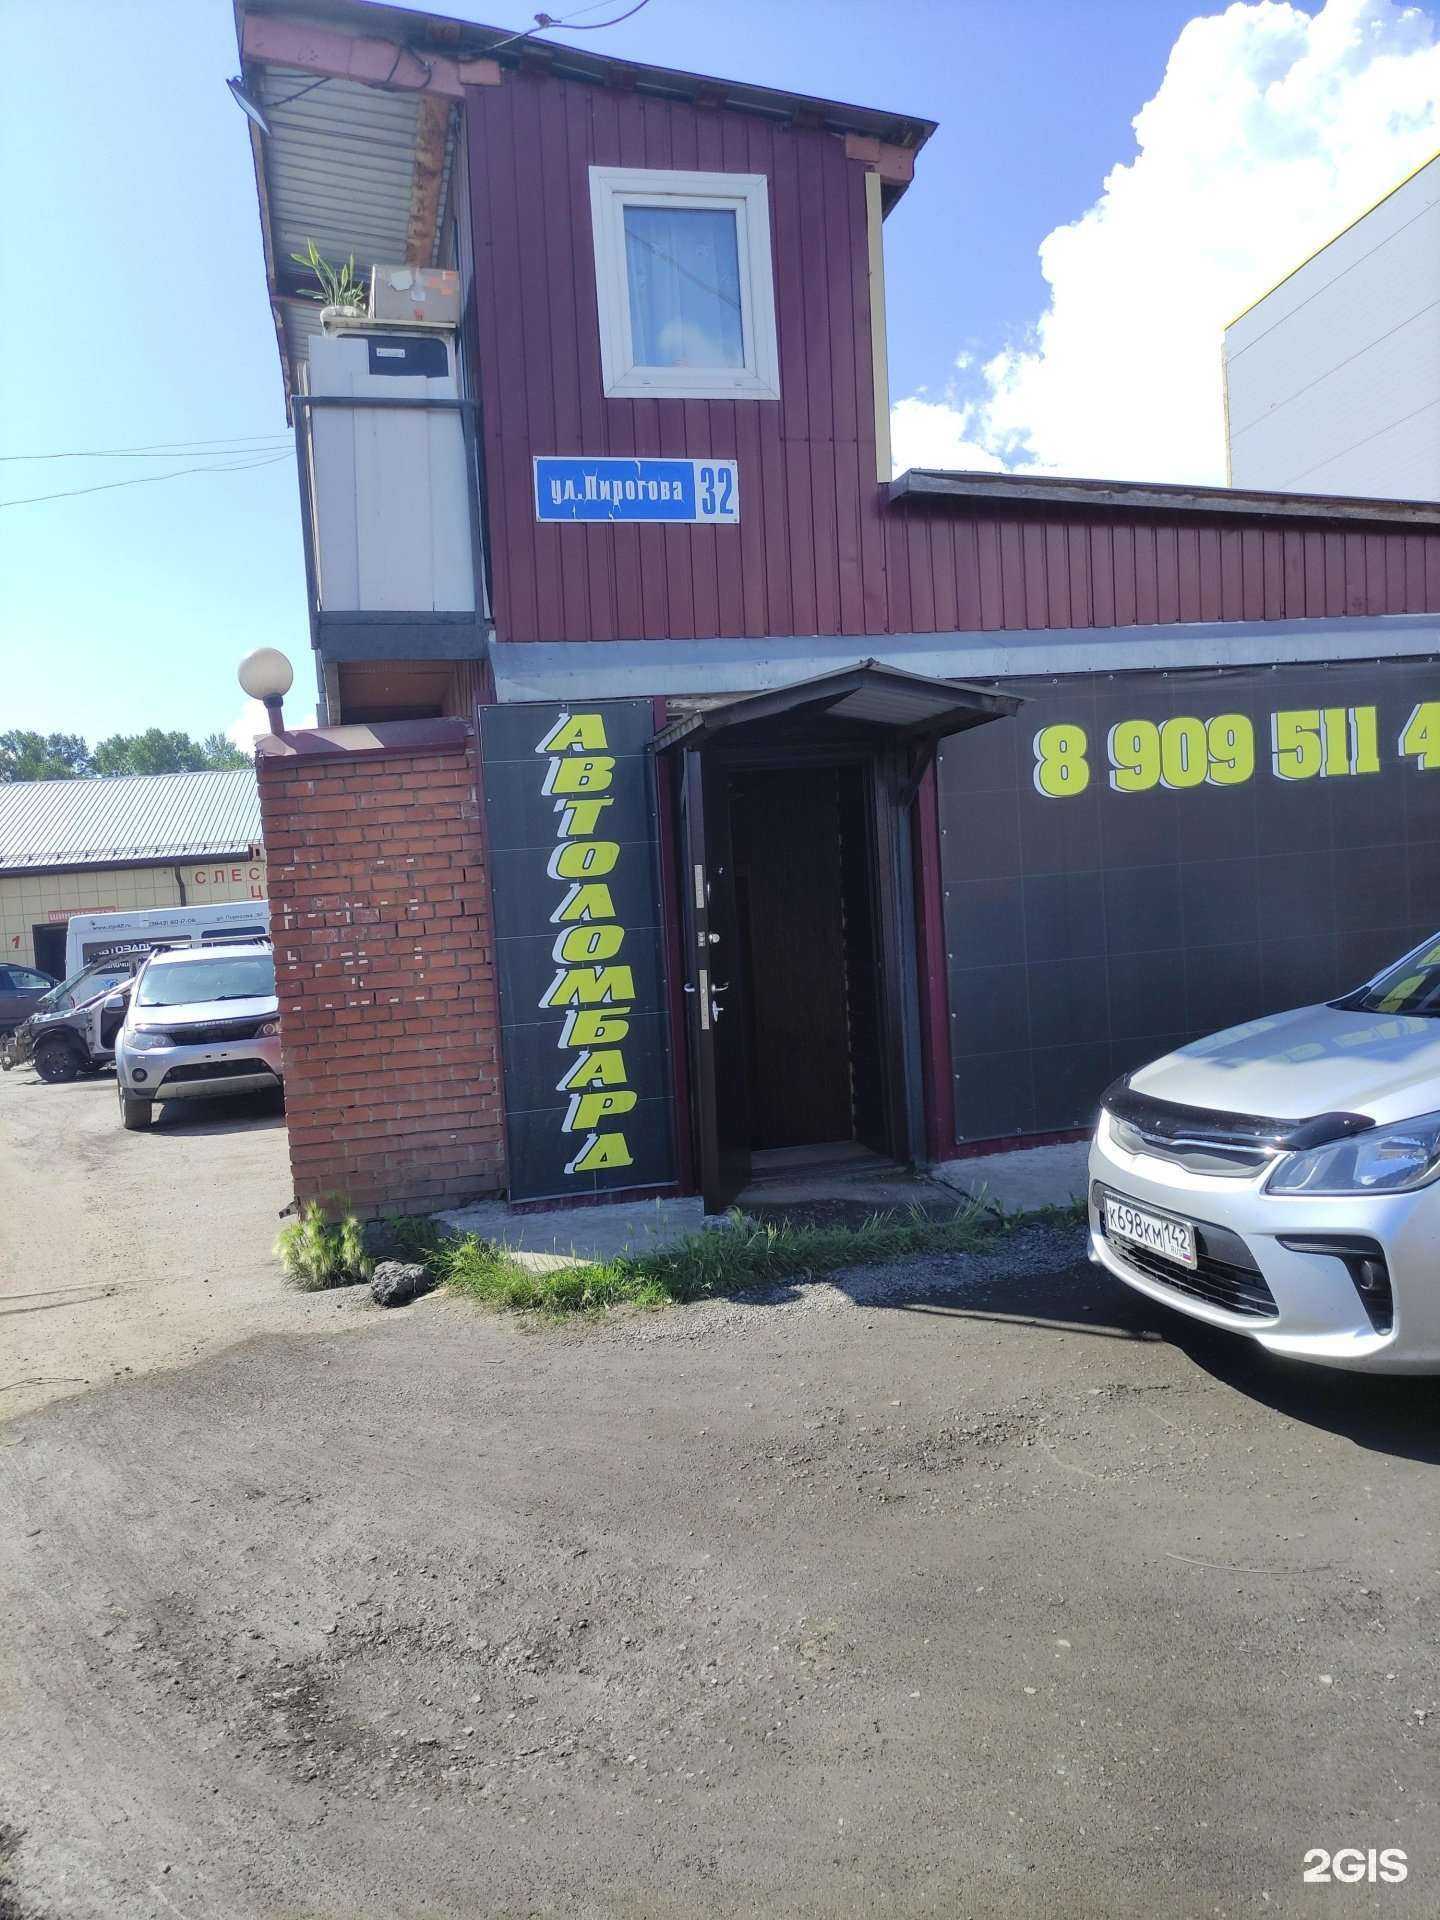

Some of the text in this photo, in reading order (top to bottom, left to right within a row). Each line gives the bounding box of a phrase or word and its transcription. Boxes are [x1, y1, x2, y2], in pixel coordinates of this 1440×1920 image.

[700, 467, 734, 515] 32
[1033, 724, 1090, 798] 8
[1107, 714, 1256, 793] 909
[1270, 705, 1380, 782] 511
[12, 935, 20, 949] 1
[535, 713, 638, 1175] АВТОЛОМБАРД
[1109, 1206, 1188, 1250] К698КМ 142
